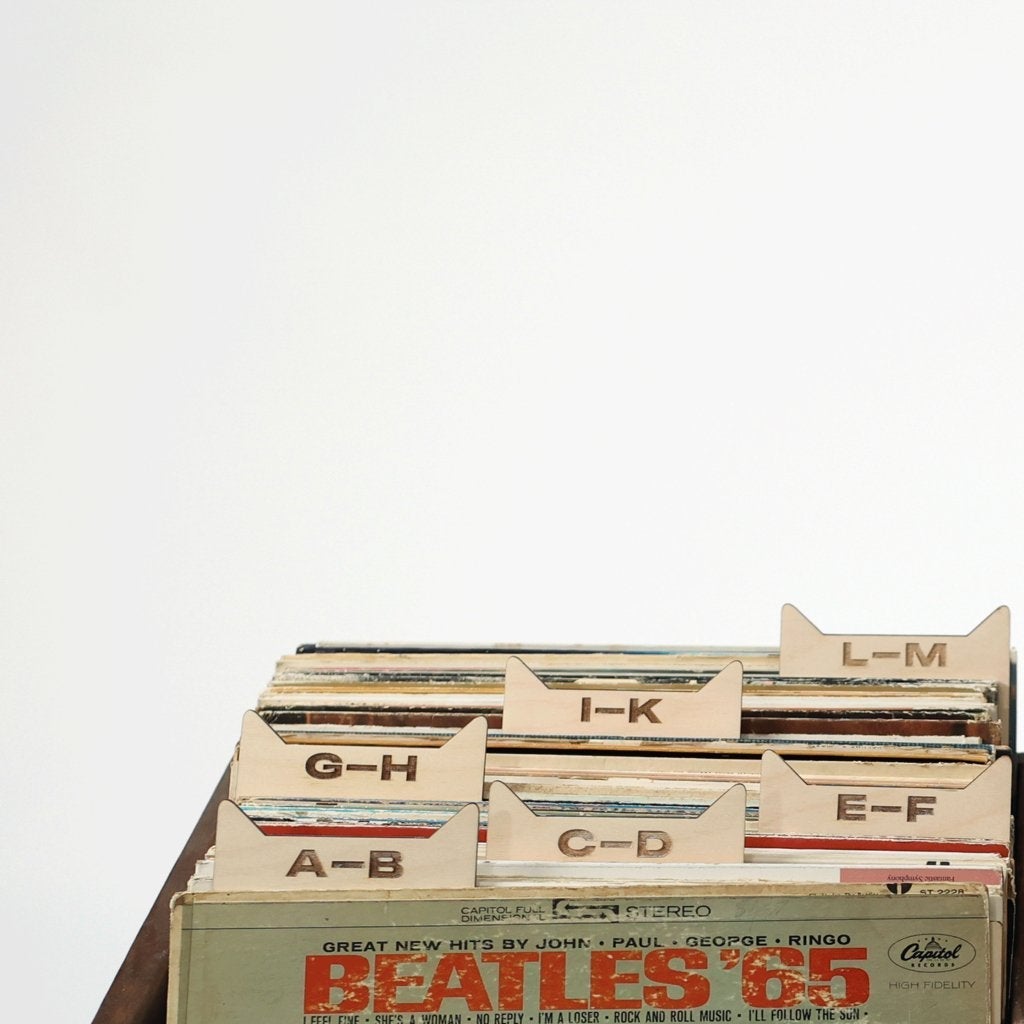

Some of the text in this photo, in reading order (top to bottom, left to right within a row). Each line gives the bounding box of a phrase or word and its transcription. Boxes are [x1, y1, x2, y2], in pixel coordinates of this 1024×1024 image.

[461, 906, 511, 914] CAPITOL
[626, 905, 712, 918] STEREO
[323, 934, 851, 952] GREAT NEW HITS BY JOHN PAUL GEORGE RINGO
[900, 942, 962, 961] Capitol
[304, 947, 870, 1014] BEATLES '65
[889, 981, 976, 990] HIGH FIDELITY
[476, 1014, 490, 1024] NO
[494, 1013, 524, 1024] REPLY
[538, 1012, 553, 1024] I'M
[557, 1012, 564, 1024] A
[568, 1011, 600, 1024] LOSER
[614, 1011, 641, 1023] ROCK
[645, 1011, 665, 1023] AND
[670, 1010, 695, 1022] ROLL
[700, 1010, 732, 1022] MUSIC
[749, 1010, 765, 1021] I'LL
[771, 1009, 811, 1021] FOLLOW
[816, 1009, 835, 1021] THE
[840, 1008, 860, 1020] SUN
